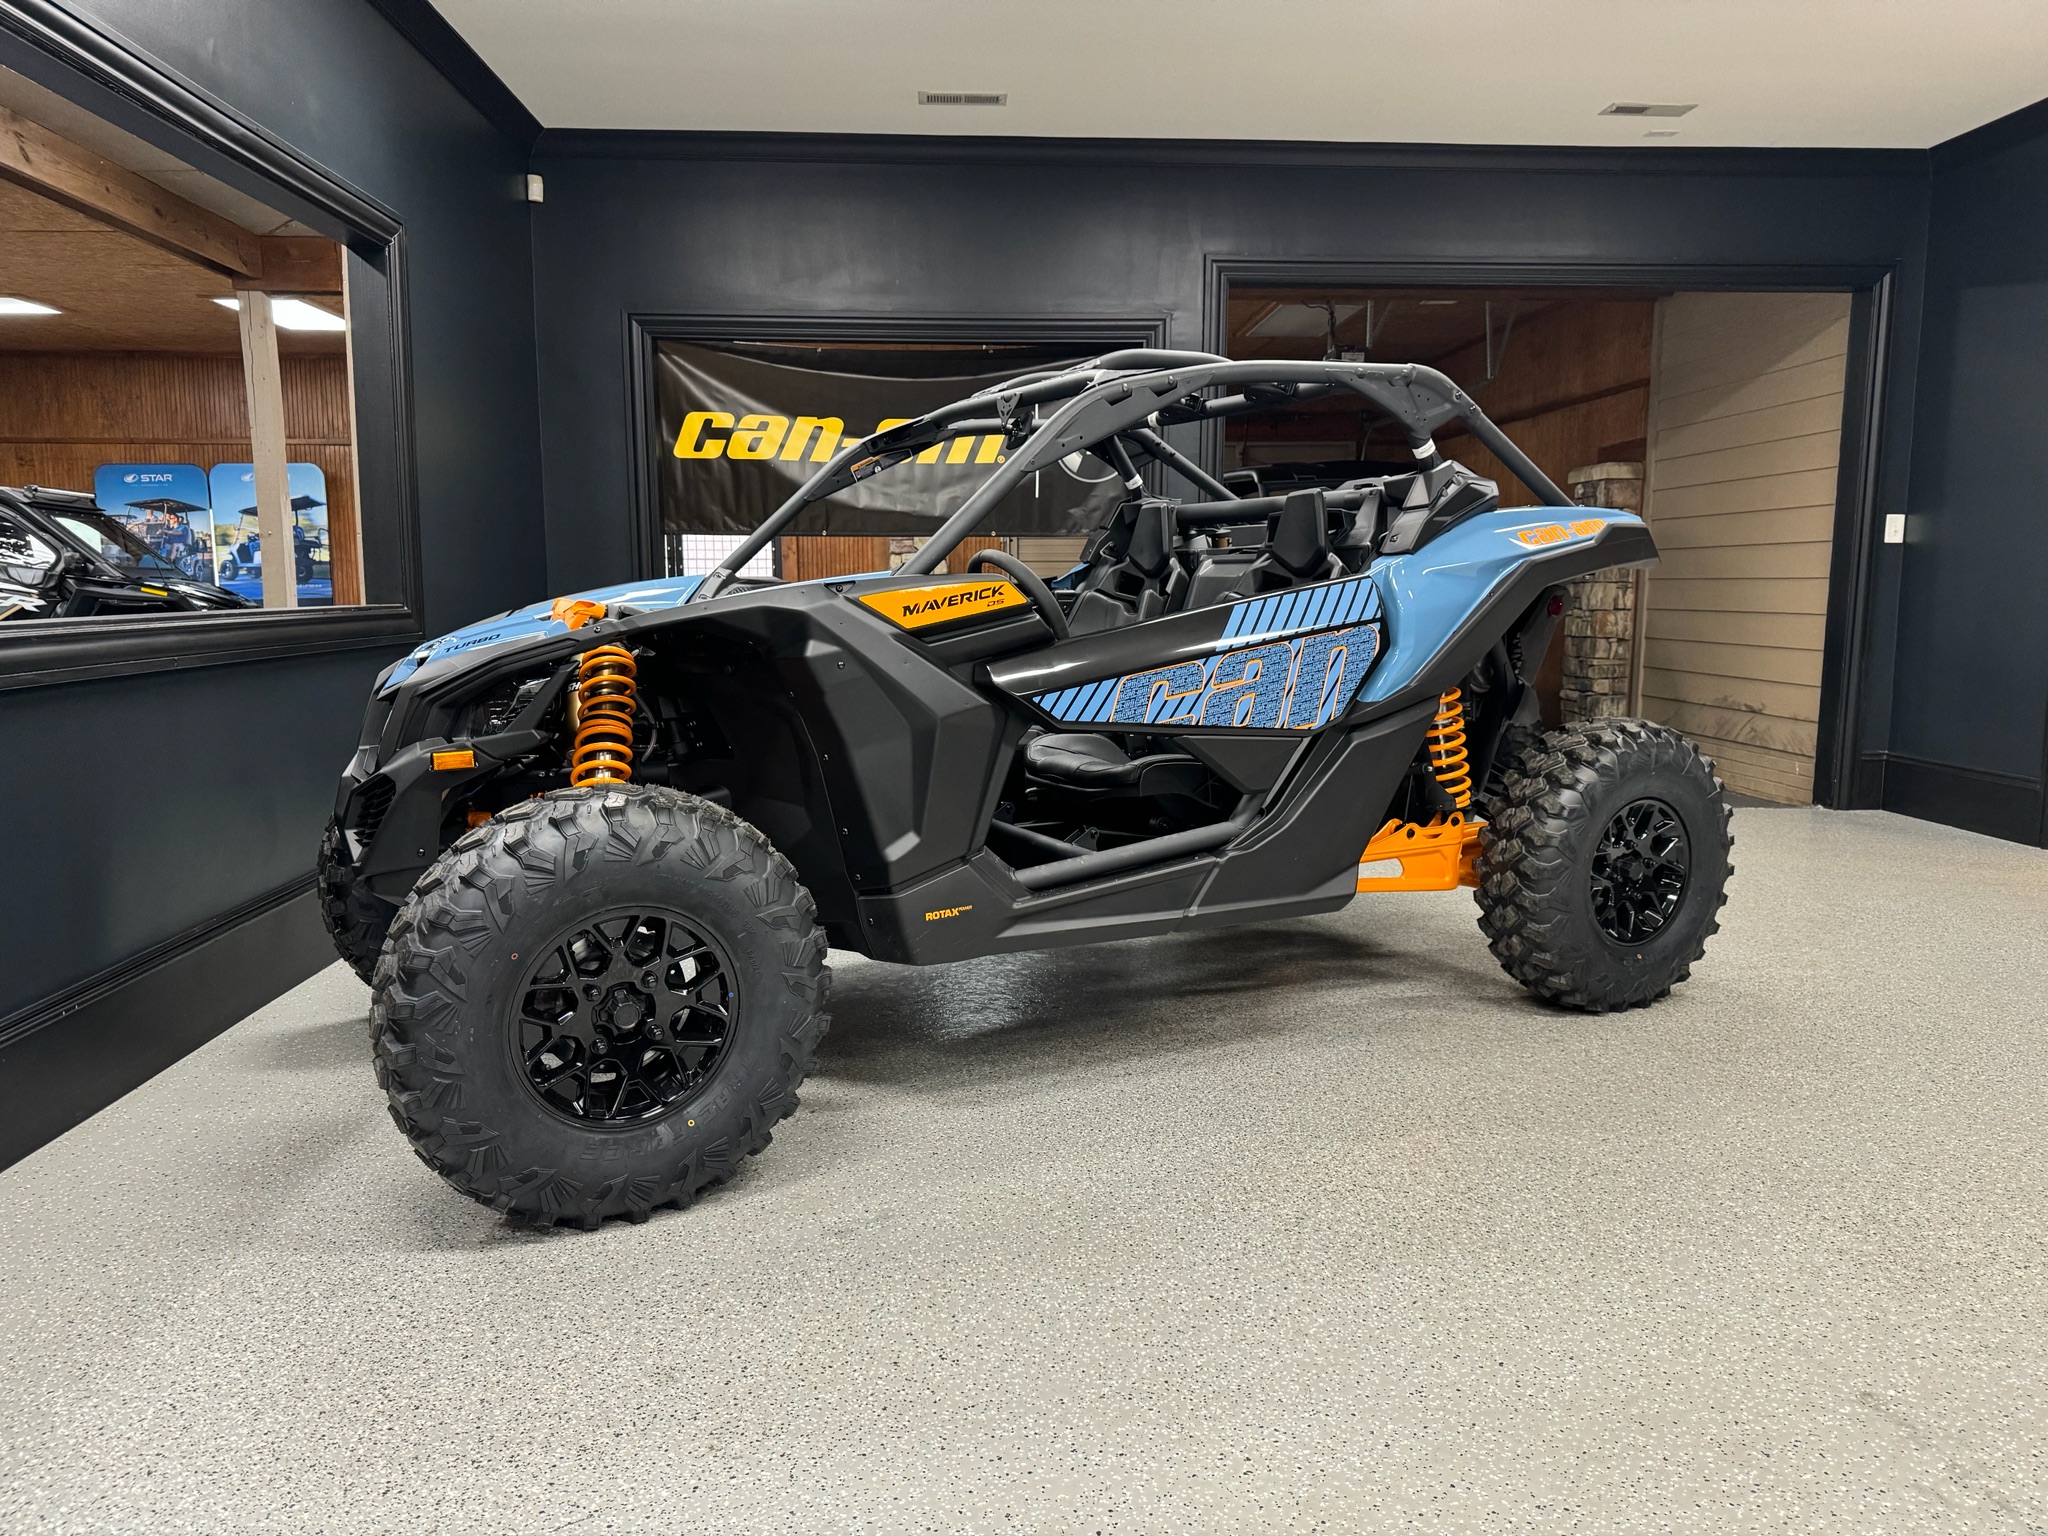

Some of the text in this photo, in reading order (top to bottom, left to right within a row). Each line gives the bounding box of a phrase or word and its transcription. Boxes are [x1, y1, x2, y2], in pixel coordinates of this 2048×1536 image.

[141, 474, 172, 482] STAR
[1517, 518, 1607, 545] can-am
[903, 584, 1005, 617] MAVERICK
[987, 598, 1005, 607] DS
[444, 633, 501, 653] TURBO
[926, 908, 959, 920] ROTAX
